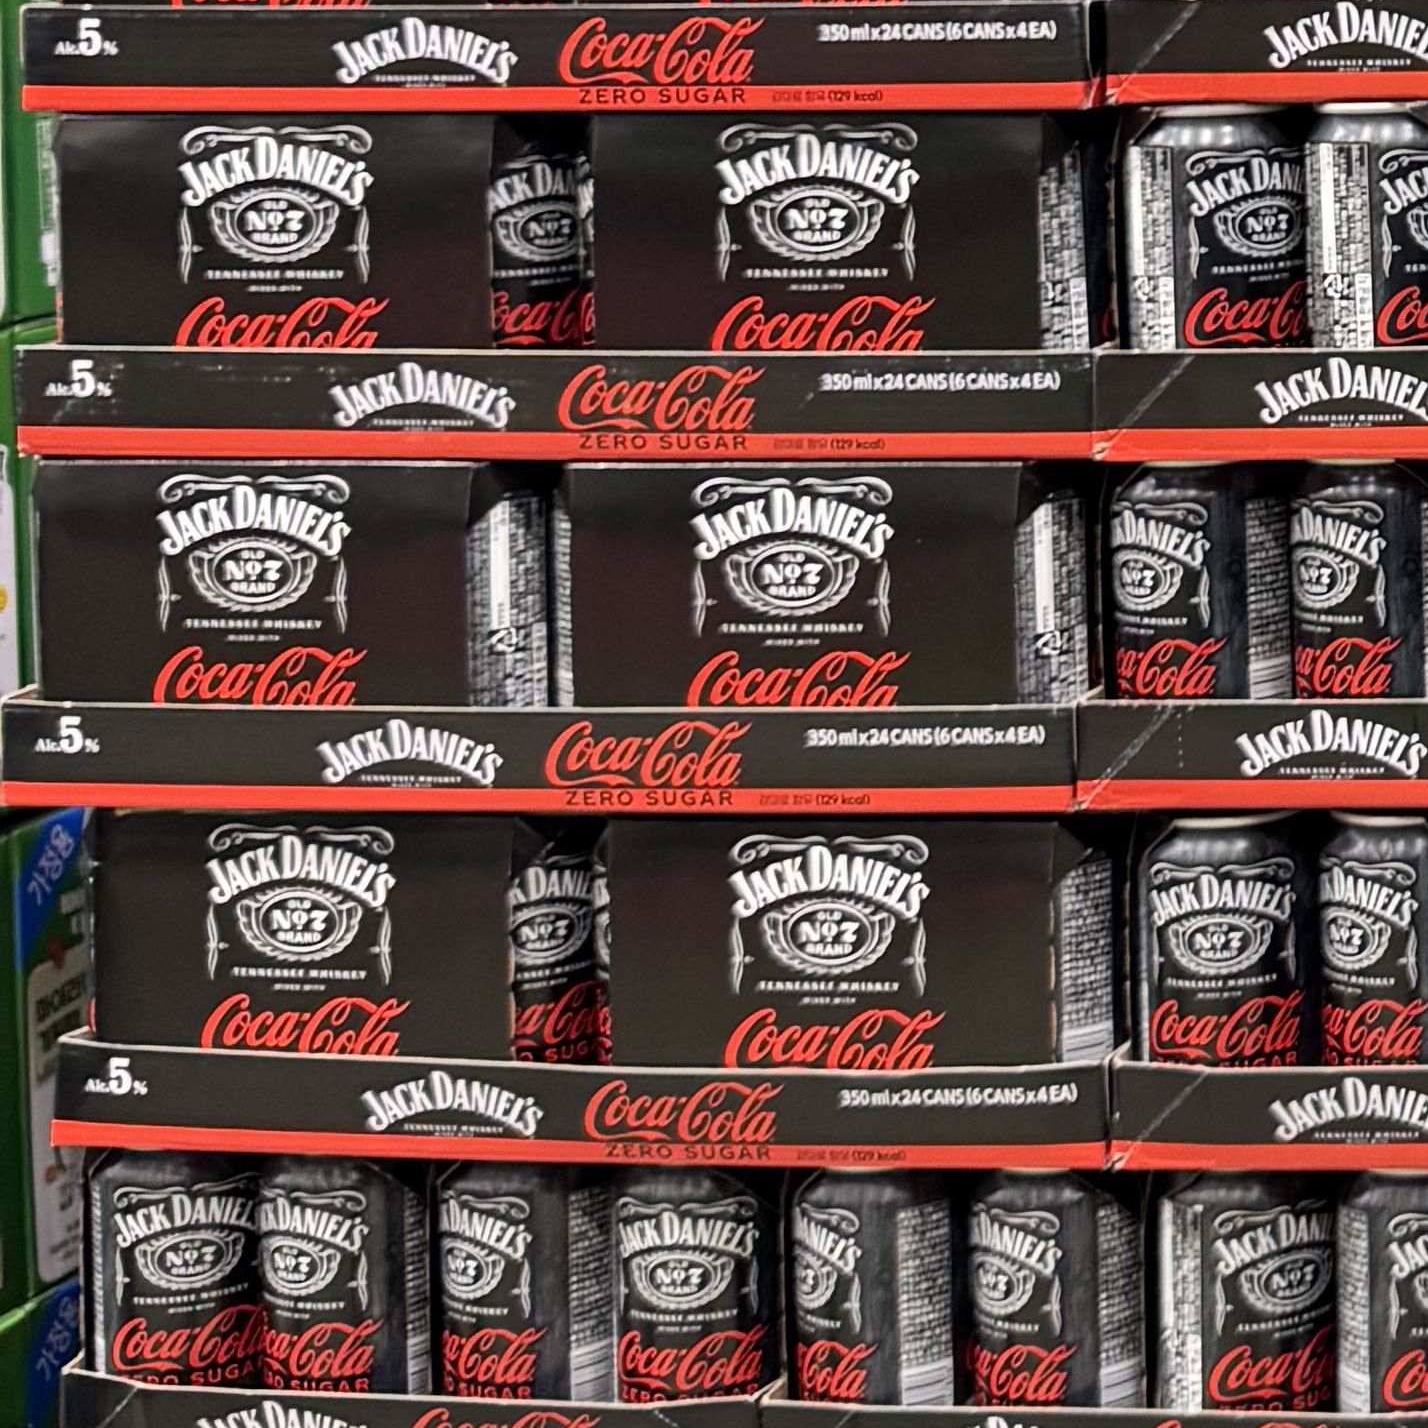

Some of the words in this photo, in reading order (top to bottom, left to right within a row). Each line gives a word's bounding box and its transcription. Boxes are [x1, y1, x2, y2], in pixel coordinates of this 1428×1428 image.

[331, 31, 402, 85] JACK
[401, 17, 518, 85] DANIEL'S
[558, 17, 765, 85] Coca-Cola
[1263, 12, 1339, 70] JACK
[579, 89, 646, 105] ZERO
[659, 88, 746, 104] SUGAR
[178, 149, 256, 207] JACK
[254, 135, 374, 207] DANIEL'S
[1254, 371, 1328, 424] JACK
[316, 731, 391, 785] JACK
[388, 719, 504, 787] DANIEL'S
[544, 721, 752, 789] Coca-Cola
[566, 790, 633, 806] ZERO
[646, 790, 733, 806] SUGAR
[360, 1083, 430, 1132] JACK
[428, 1070, 544, 1139] DANIEL'S
[584, 1080, 785, 1144] Coca-Cola
[1269, 1086, 1346, 1142] JACK
[606, 1145, 675, 1161] ZERO
[683, 1145, 772, 1161] SUGAR
